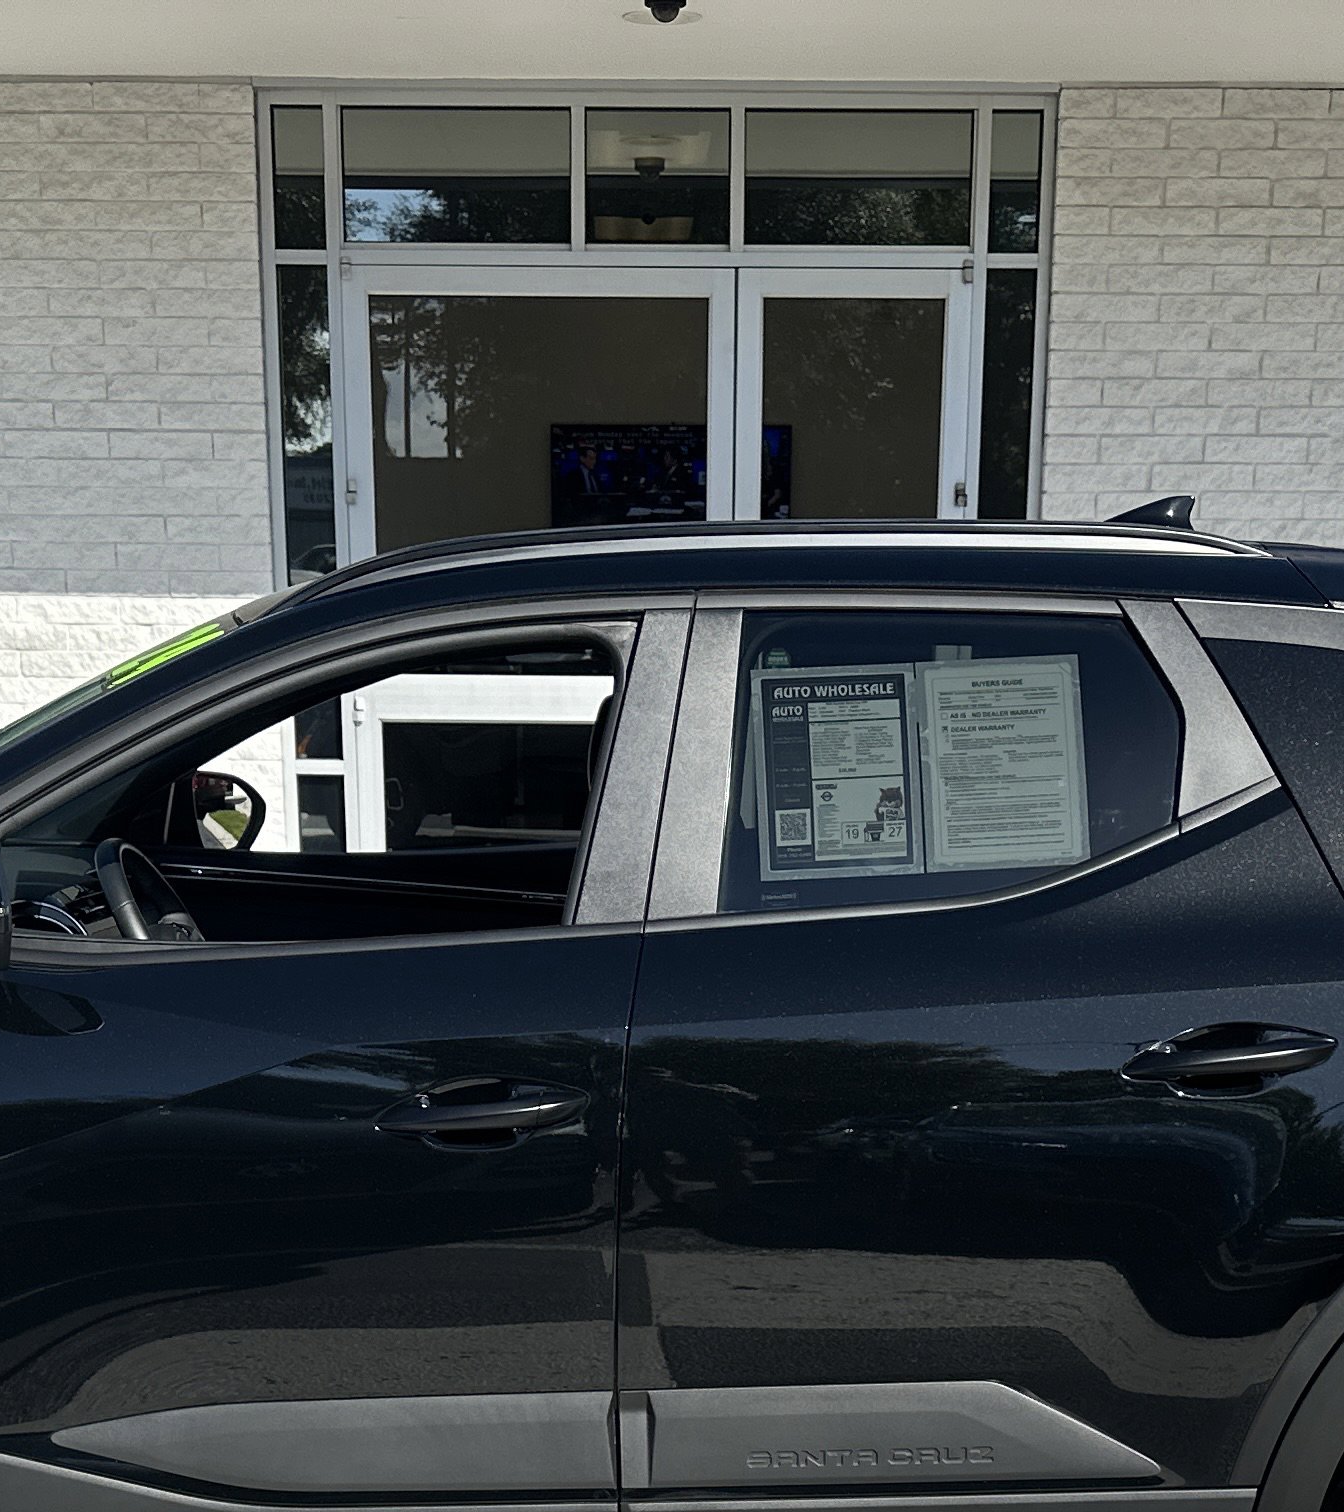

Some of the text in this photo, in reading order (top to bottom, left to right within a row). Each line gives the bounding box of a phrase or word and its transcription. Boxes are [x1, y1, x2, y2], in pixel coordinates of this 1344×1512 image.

[971, 680, 1000, 688] BUYERS
[773, 682, 895, 700] AUTO WHOLESALE
[771, 705, 803, 718] AUTO
[844, 828, 860, 840] 19
[888, 825, 903, 838] 27
[745, 1445, 996, 1470] SANTA CRUZ
